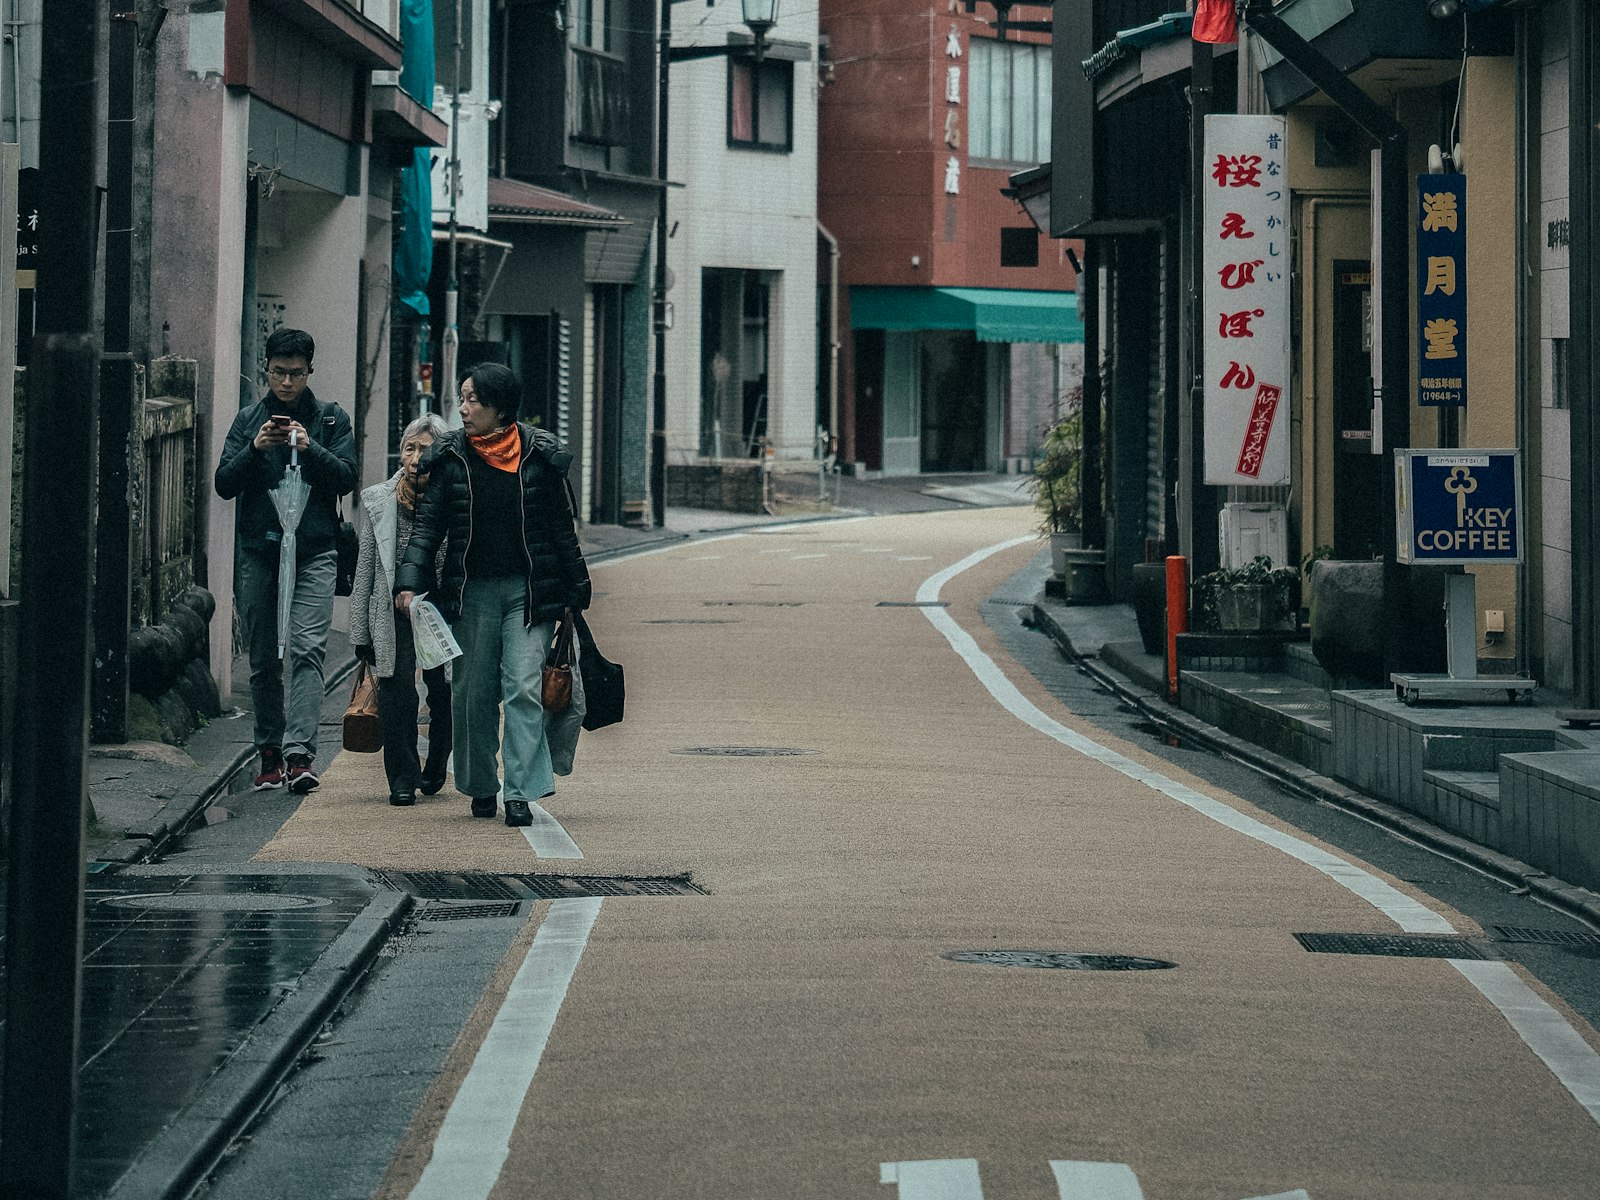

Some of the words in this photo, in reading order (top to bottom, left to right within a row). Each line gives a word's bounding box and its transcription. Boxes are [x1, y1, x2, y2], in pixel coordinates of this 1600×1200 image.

[1211, 154, 1265, 389] 桜えびぽん
[1265, 133, 1282, 282] 昔なつかしい
[1422, 191, 1459, 360] 満月堂
[1417, 529, 1511, 551] COFFEE
[1464, 507, 1512, 528] KEY
